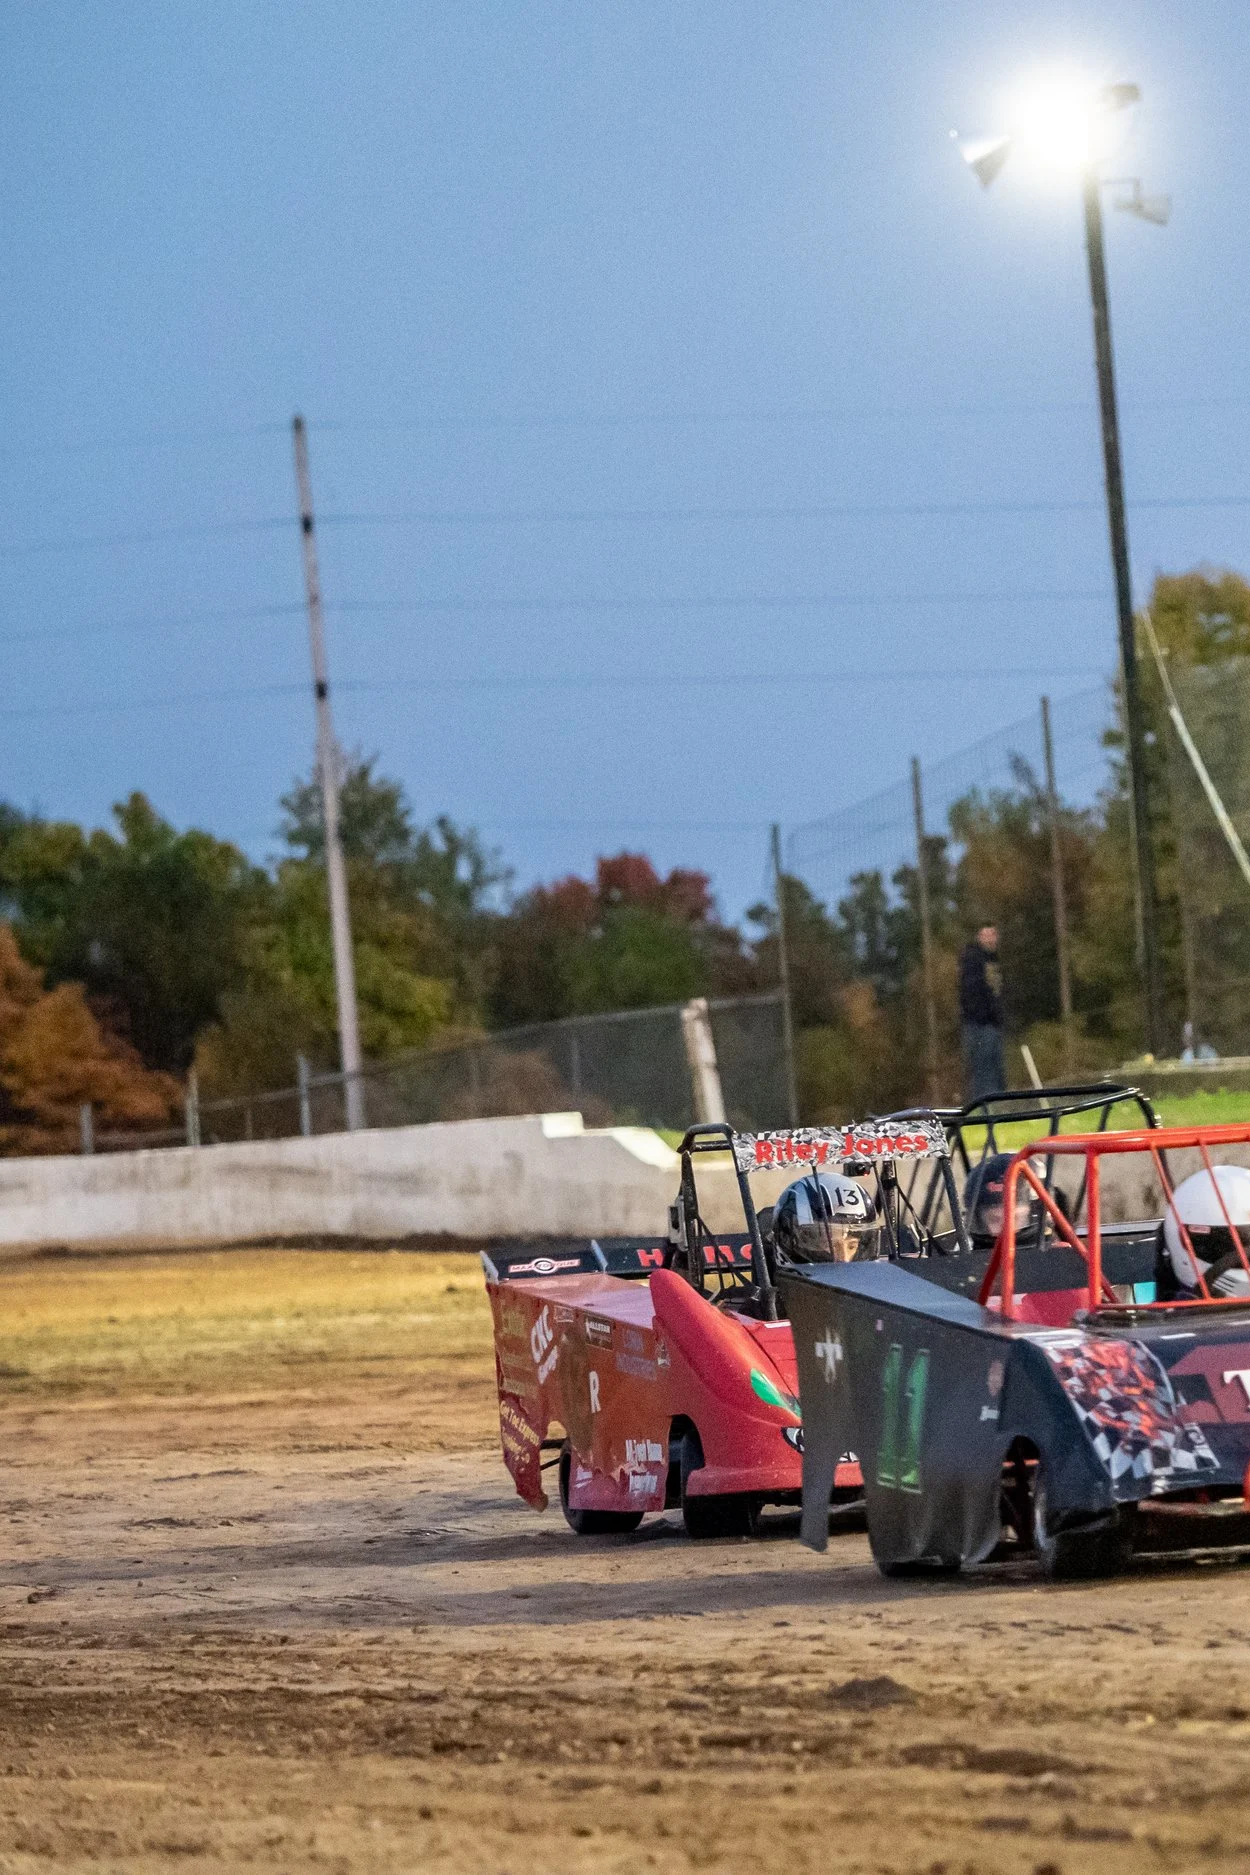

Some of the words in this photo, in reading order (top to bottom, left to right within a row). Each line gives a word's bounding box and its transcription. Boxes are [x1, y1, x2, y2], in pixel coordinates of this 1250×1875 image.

[755, 1138, 829, 1165] Riley
[841, 1132, 929, 1156] Jones
[834, 1187, 860, 1207] 13
